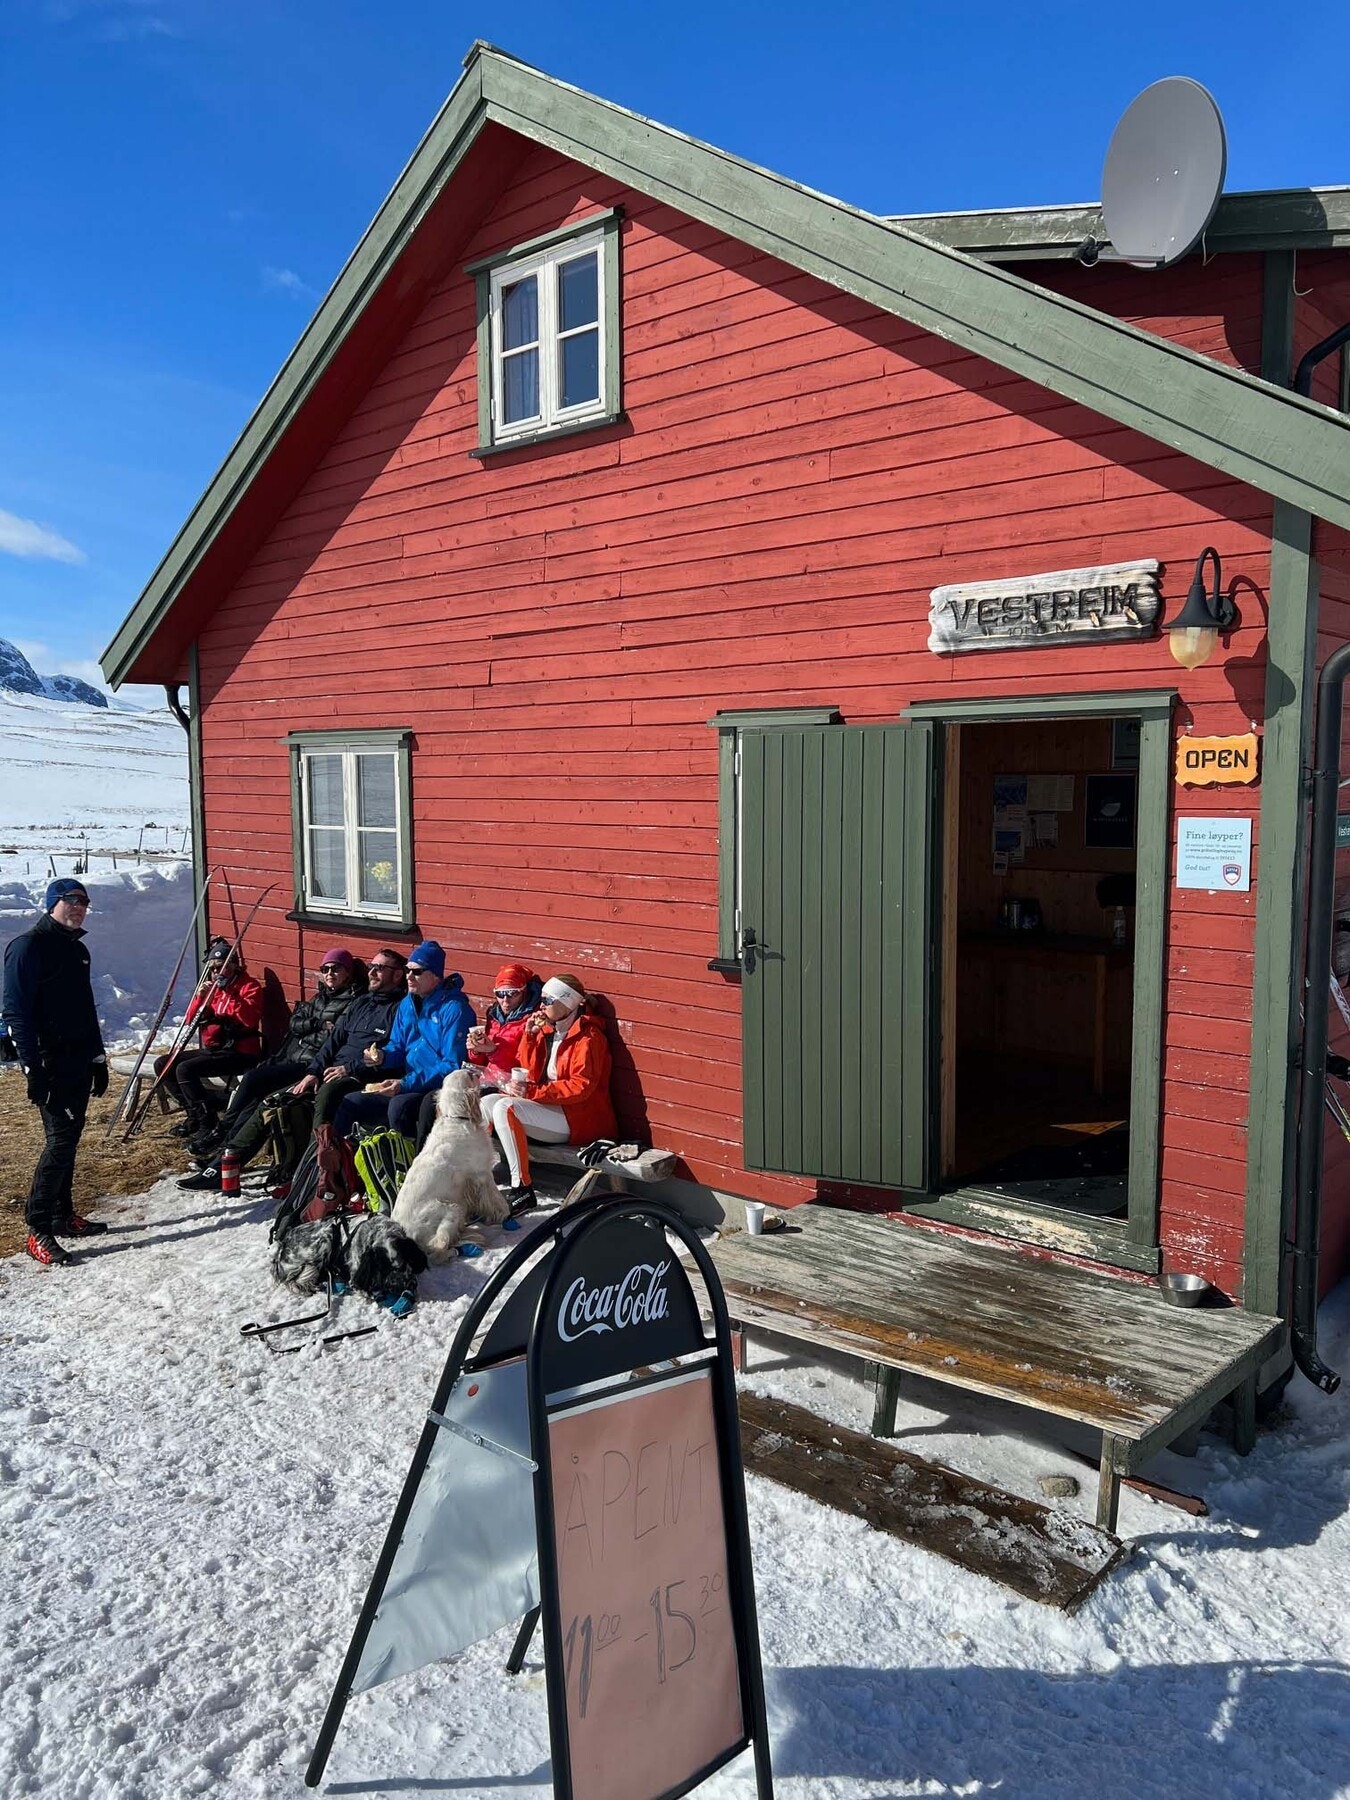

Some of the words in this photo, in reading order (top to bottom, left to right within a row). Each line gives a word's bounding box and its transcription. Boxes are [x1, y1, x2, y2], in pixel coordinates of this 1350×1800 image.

[1186, 749, 1248, 768] OPEN
[1186, 831, 1206, 840] Fine
[1209, 831, 1243, 842] løyper?
[558, 1260, 671, 1342] Coca-Cola
[559, 1440, 708, 1568] ÅPENT
